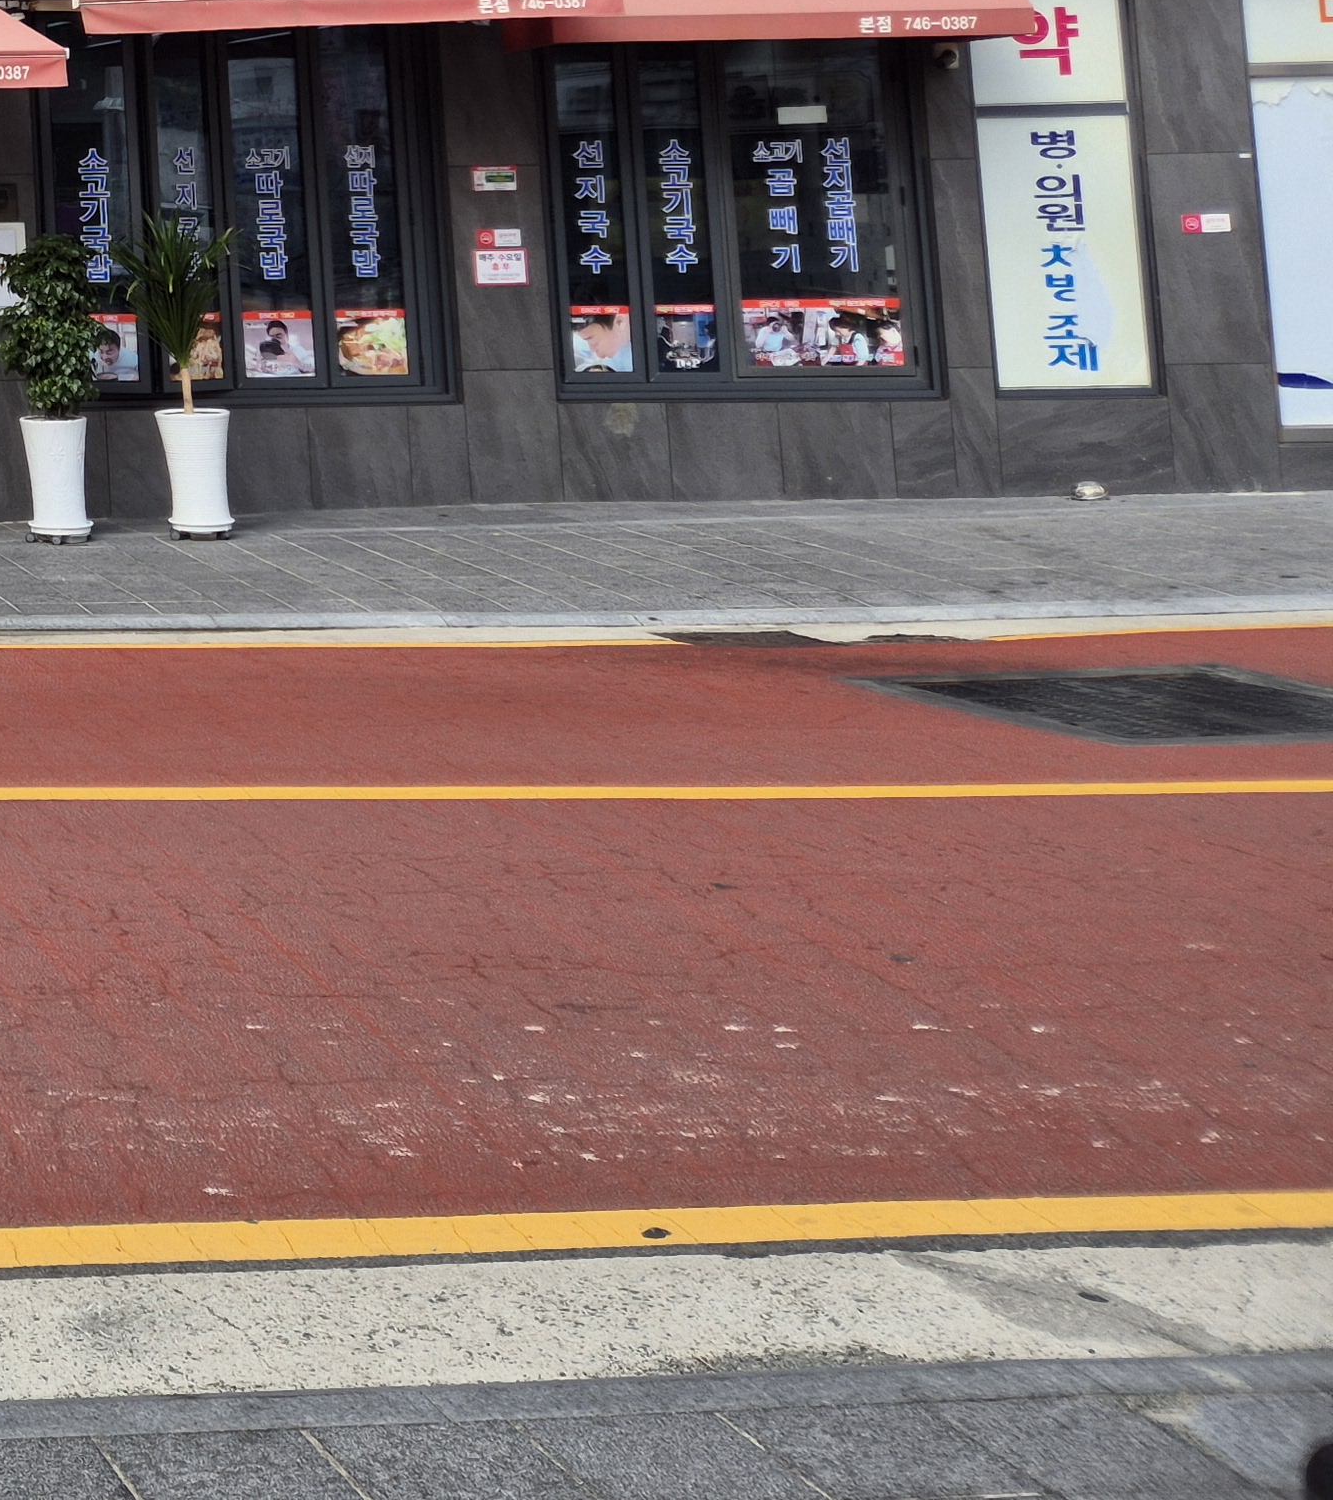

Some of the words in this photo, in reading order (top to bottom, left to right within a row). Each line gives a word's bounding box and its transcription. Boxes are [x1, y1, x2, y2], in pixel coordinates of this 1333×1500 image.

[859, 16, 892, 34] 본점
[903, 16, 978, 30] 746-0387
[245, 146, 291, 170] 소고기
[344, 145, 375, 168] 선지
[752, 139, 803, 163] 소고기
[255, 171, 288, 280] 따로국밥
[347, 169, 381, 278] 따로국밥
[572, 140, 613, 274] 선지국수
[659, 139, 699, 273] 소고기국수
[765, 168, 801, 273] 곱빼기
[821, 137, 859, 273] 선지곱빼기
